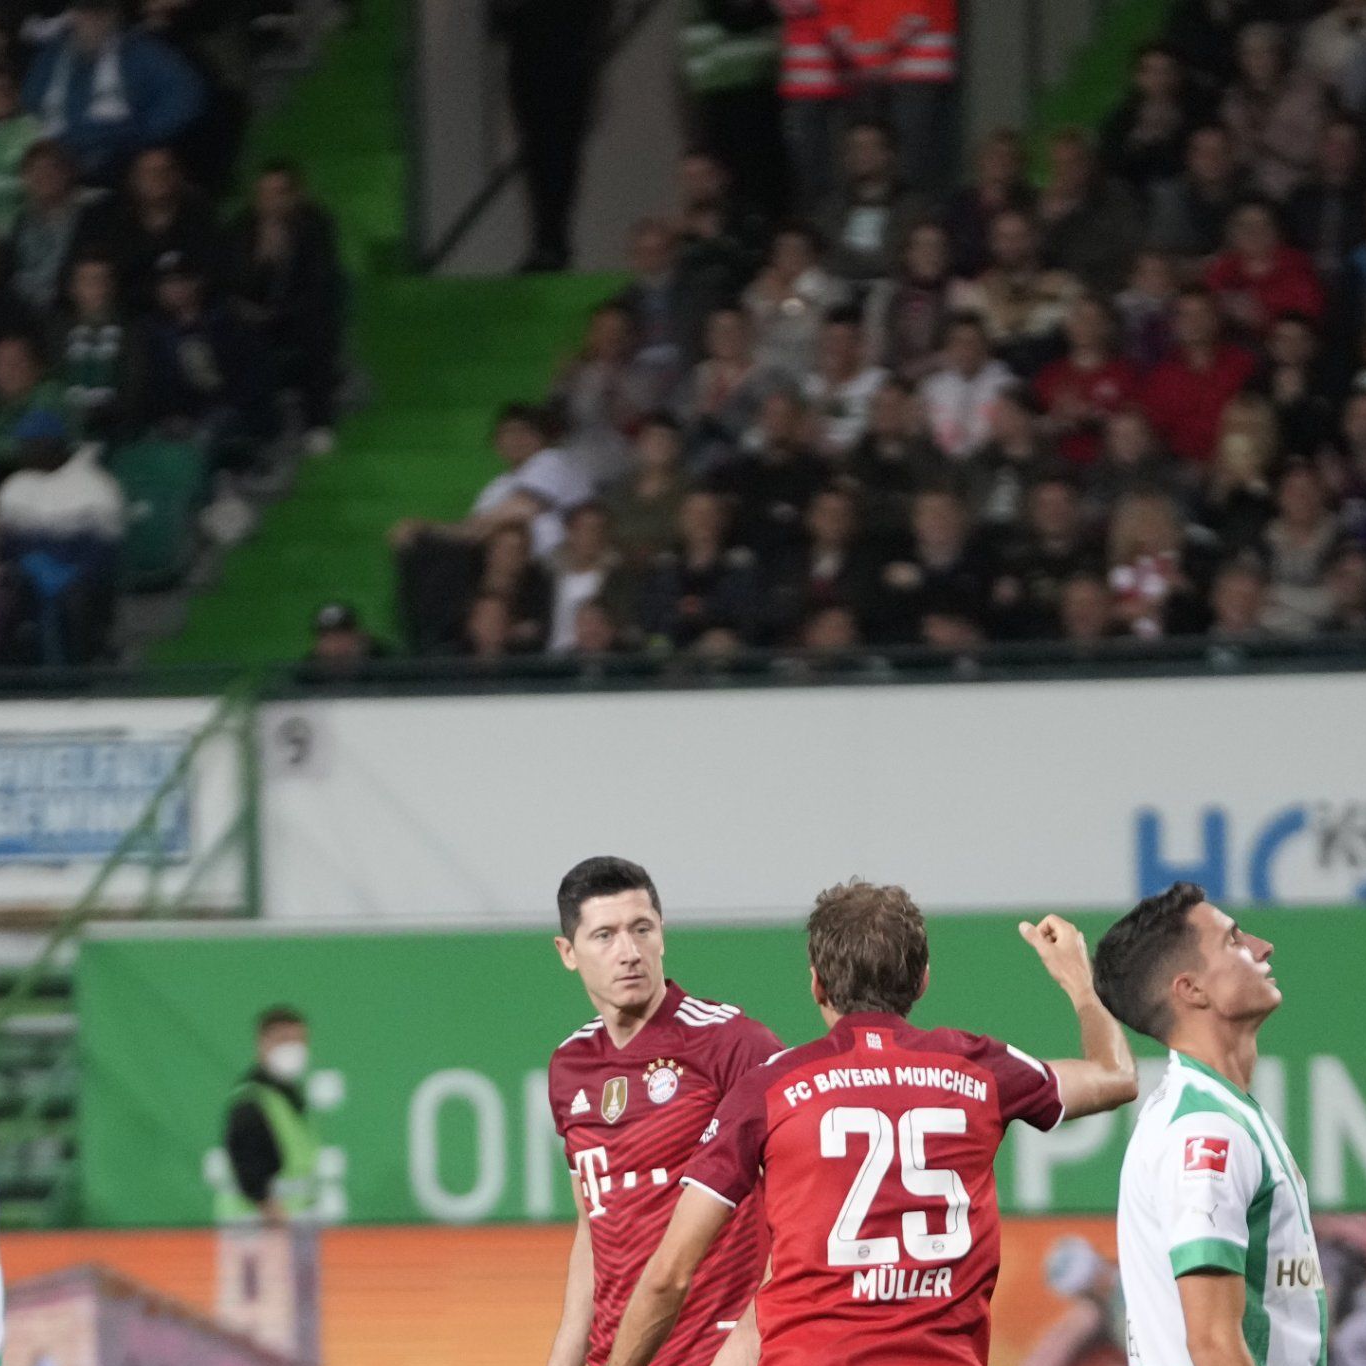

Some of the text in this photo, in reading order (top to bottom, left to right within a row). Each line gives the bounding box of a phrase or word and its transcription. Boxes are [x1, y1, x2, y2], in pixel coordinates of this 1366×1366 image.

[783, 1066, 988, 1108] FC BAYERN MÜNCHEN
[819, 1106, 973, 1267] 25
[852, 1263, 953, 1301] MÜLLER
